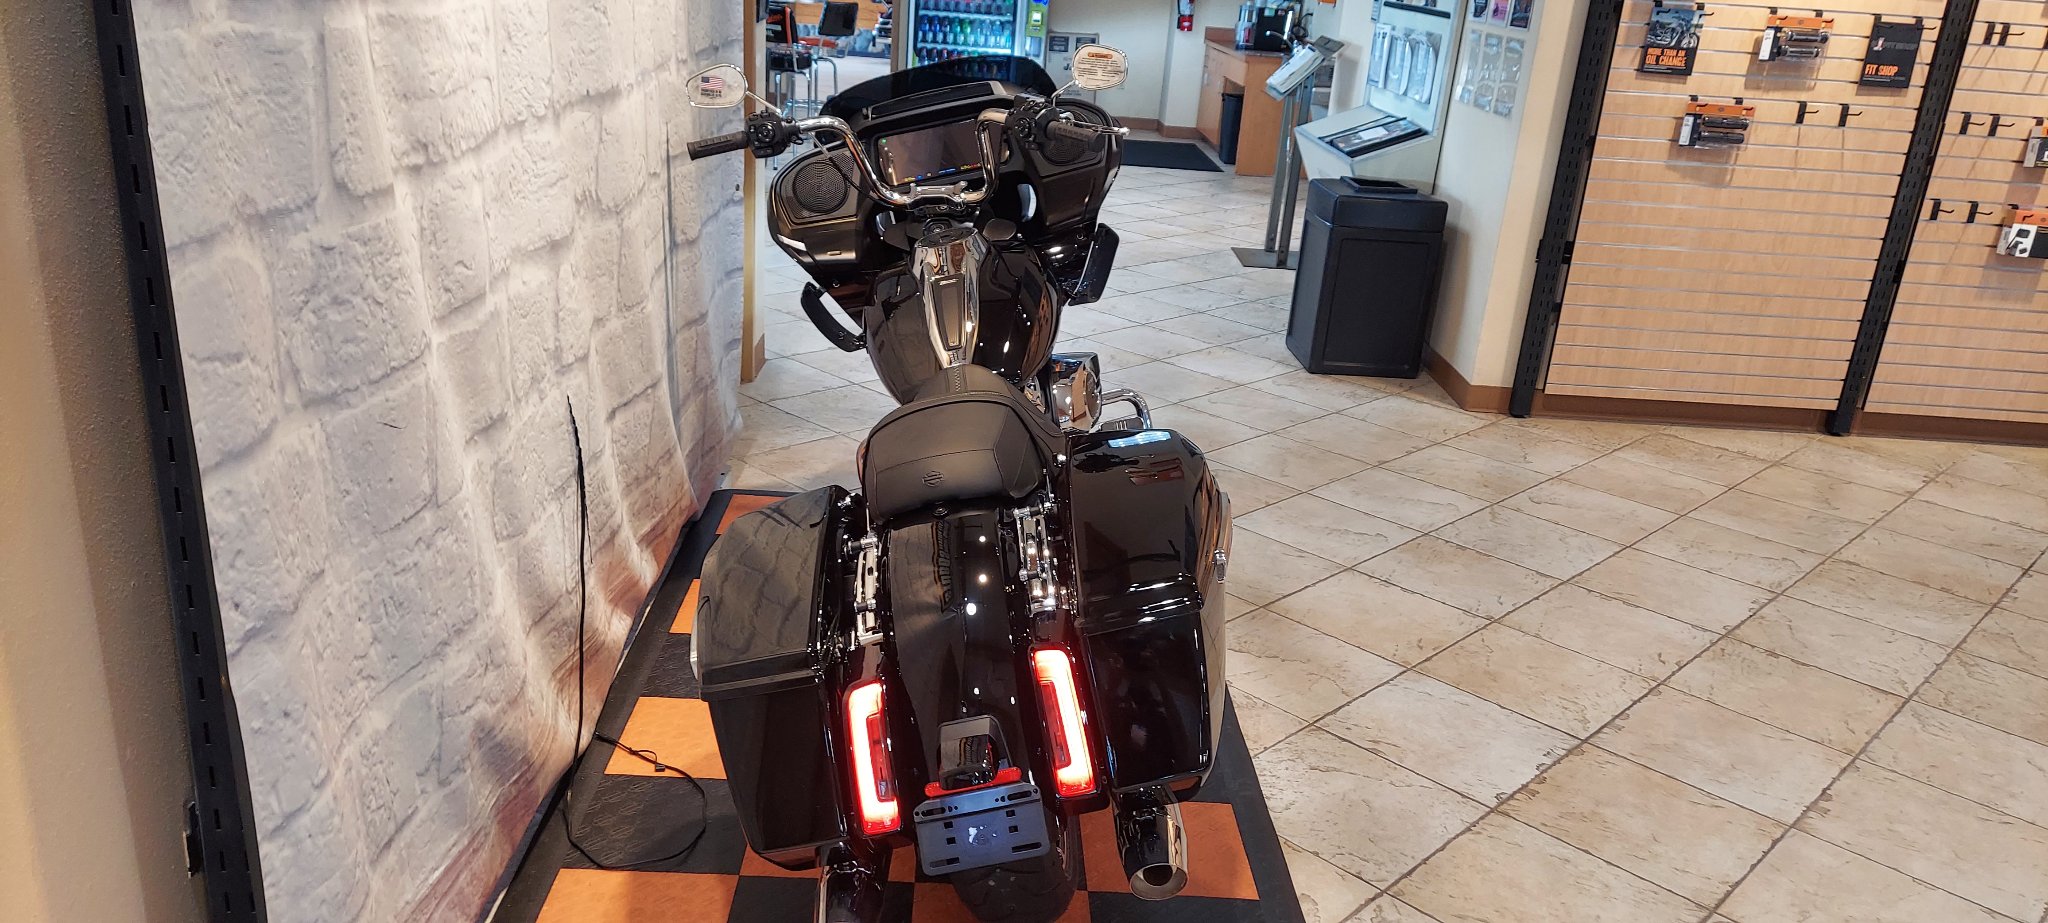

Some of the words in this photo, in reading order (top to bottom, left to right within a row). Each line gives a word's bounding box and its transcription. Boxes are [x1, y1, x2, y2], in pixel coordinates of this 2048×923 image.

[1663, 48, 1678, 56] THAN
[1678, 49, 1686, 57] AN
[1645, 55, 1657, 65] OIL
[1658, 55, 1686, 67] CHANGE
[1865, 63, 1878, 75] FIT
[1878, 65, 1898, 76] SHOP
